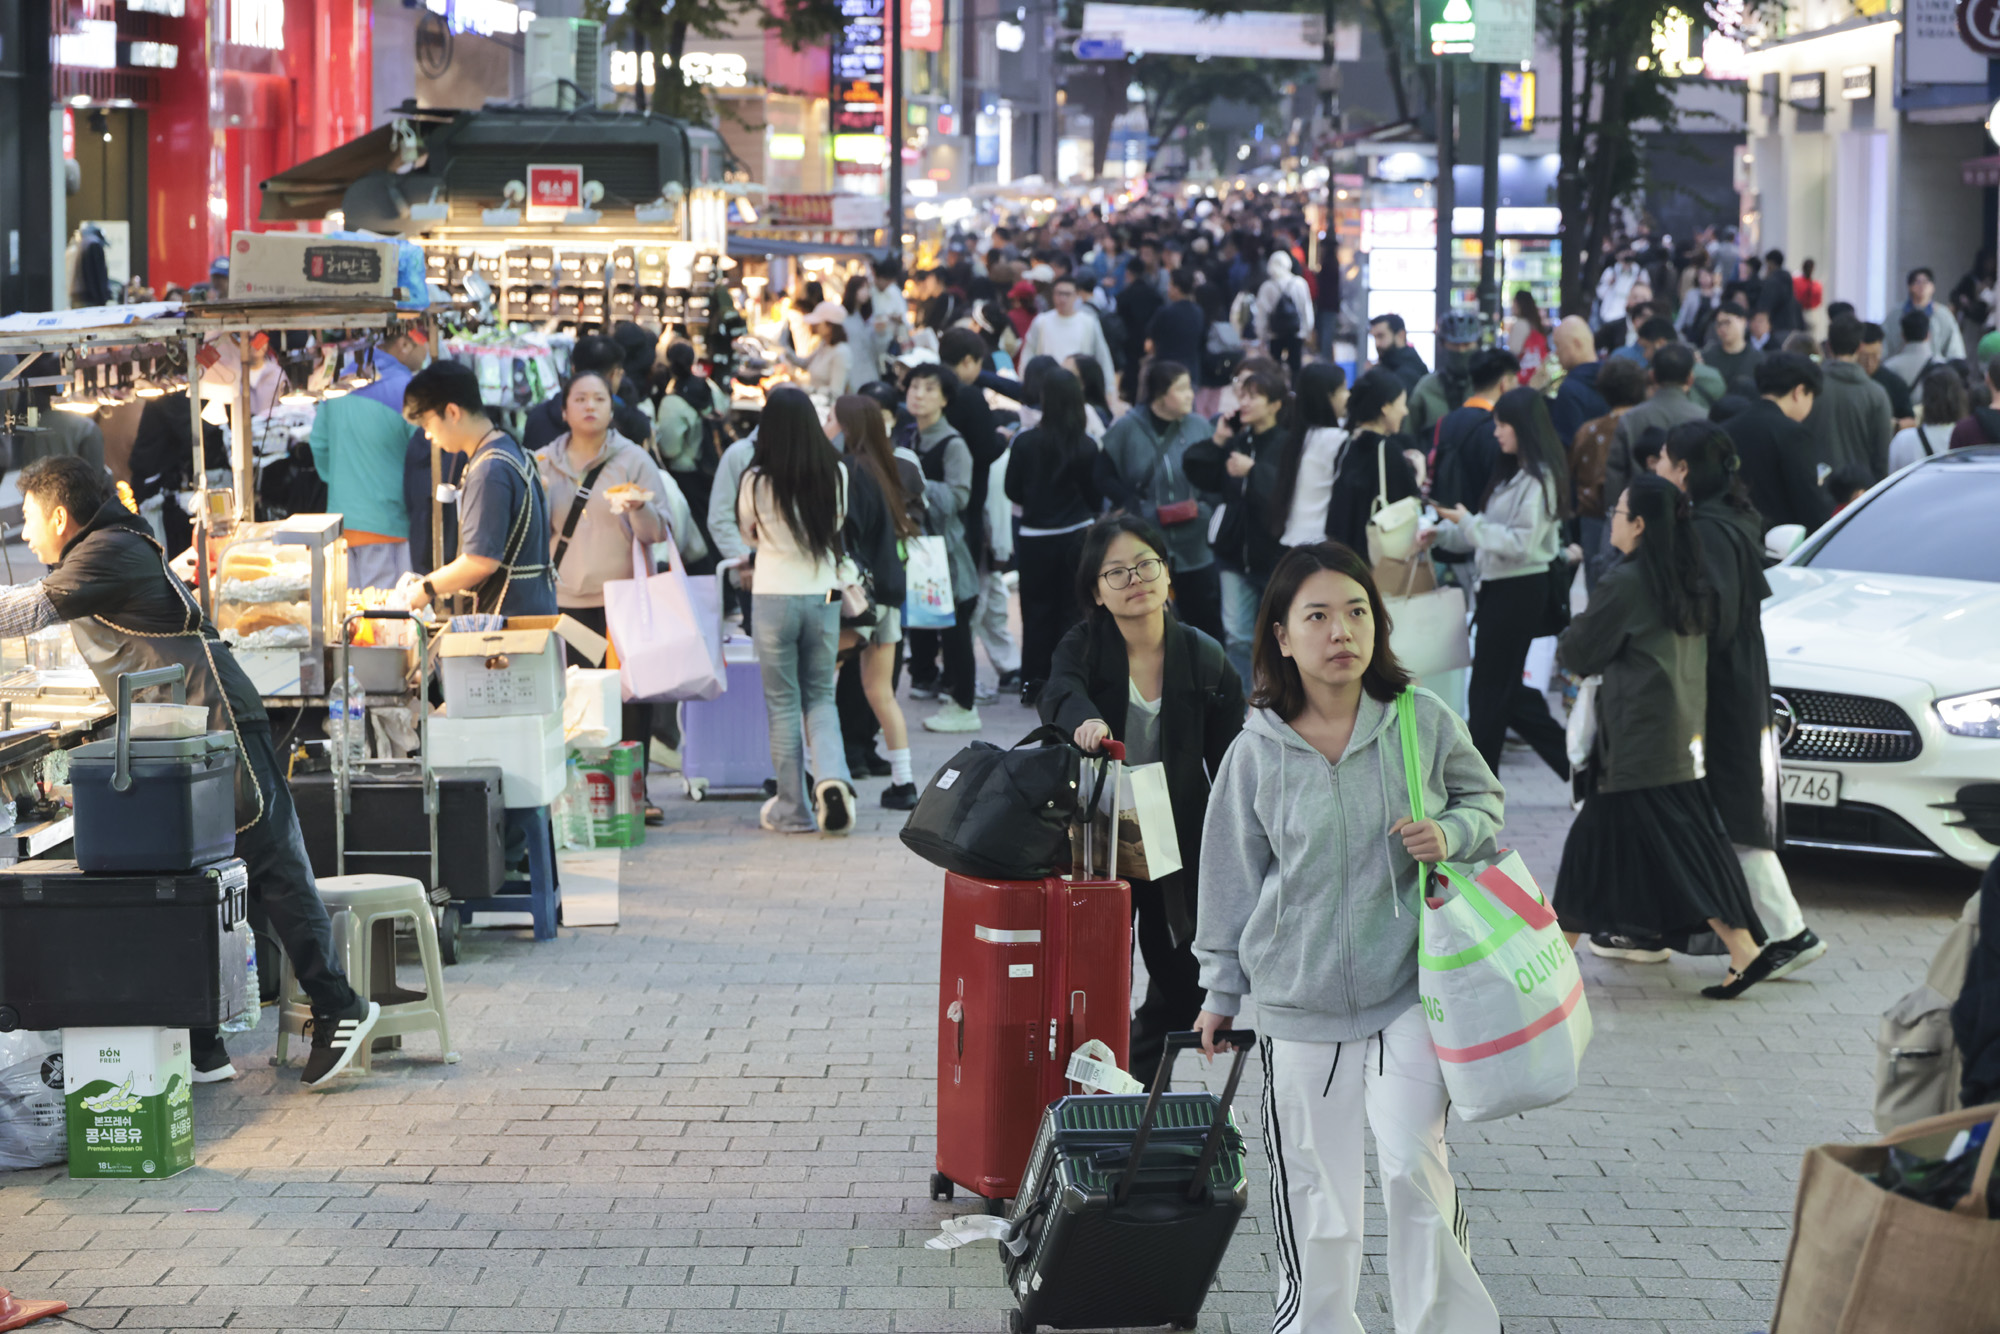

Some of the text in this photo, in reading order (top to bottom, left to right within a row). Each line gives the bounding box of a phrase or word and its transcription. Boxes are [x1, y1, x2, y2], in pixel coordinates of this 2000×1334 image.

[1781, 774, 1831, 801] 746
[94, 1116, 132, 1126] 본프레쉬
[85, 1128, 143, 1144] 콩식용유
[112, 1145, 135, 1153] Soybean
